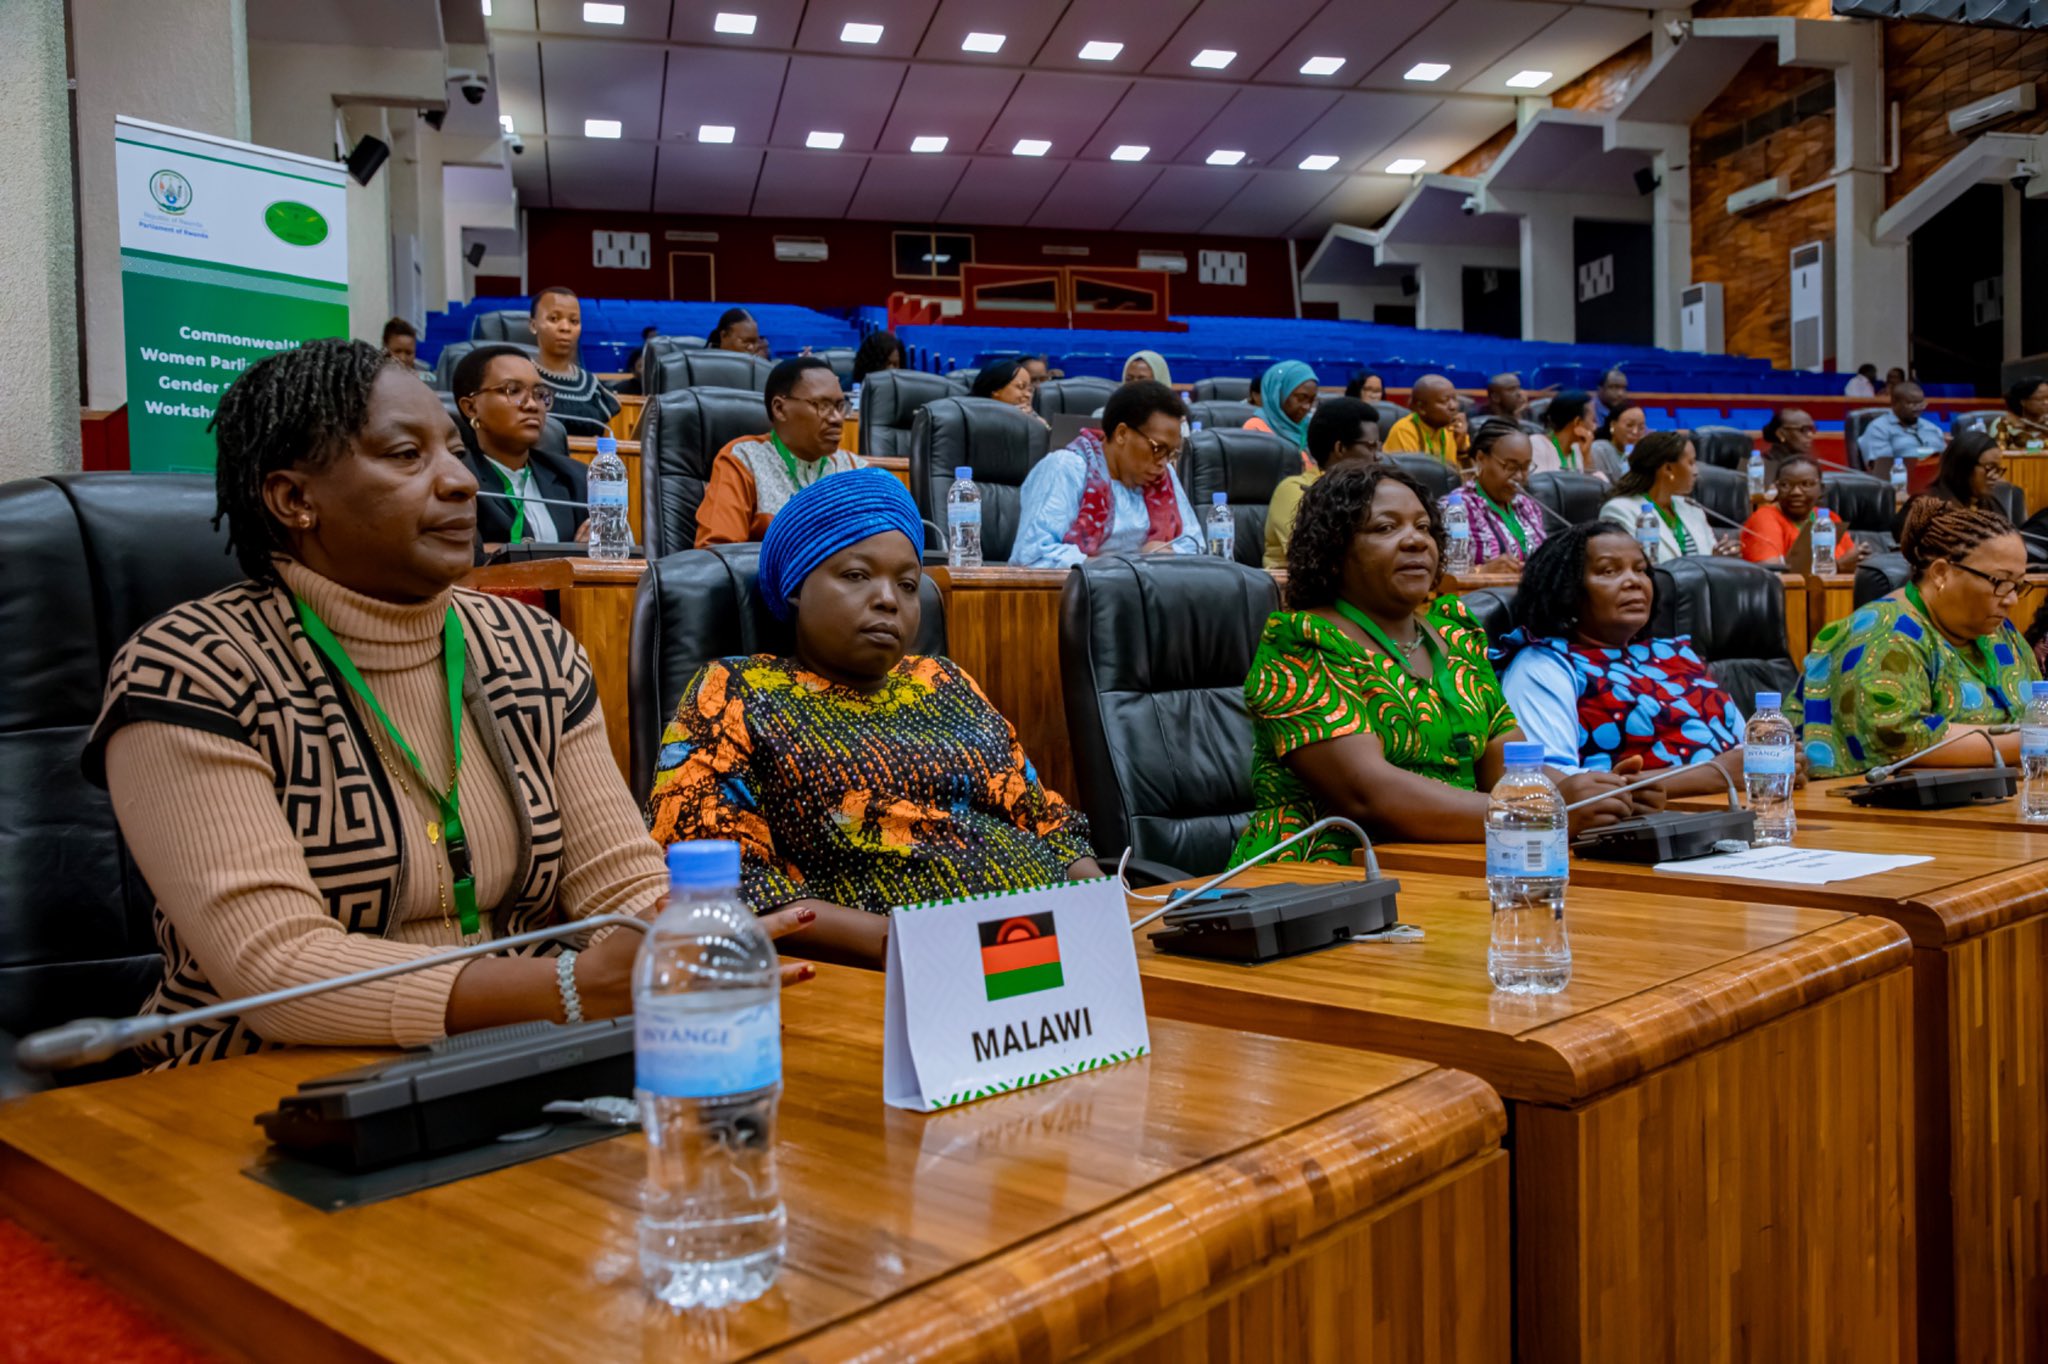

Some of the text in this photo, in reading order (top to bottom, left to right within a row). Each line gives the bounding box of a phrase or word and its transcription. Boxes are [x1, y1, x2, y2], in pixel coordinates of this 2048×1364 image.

[140, 347, 251, 371] Women Parli
[158, 376, 219, 394] Gender
[972, 1007, 1092, 1063] MALAWI
